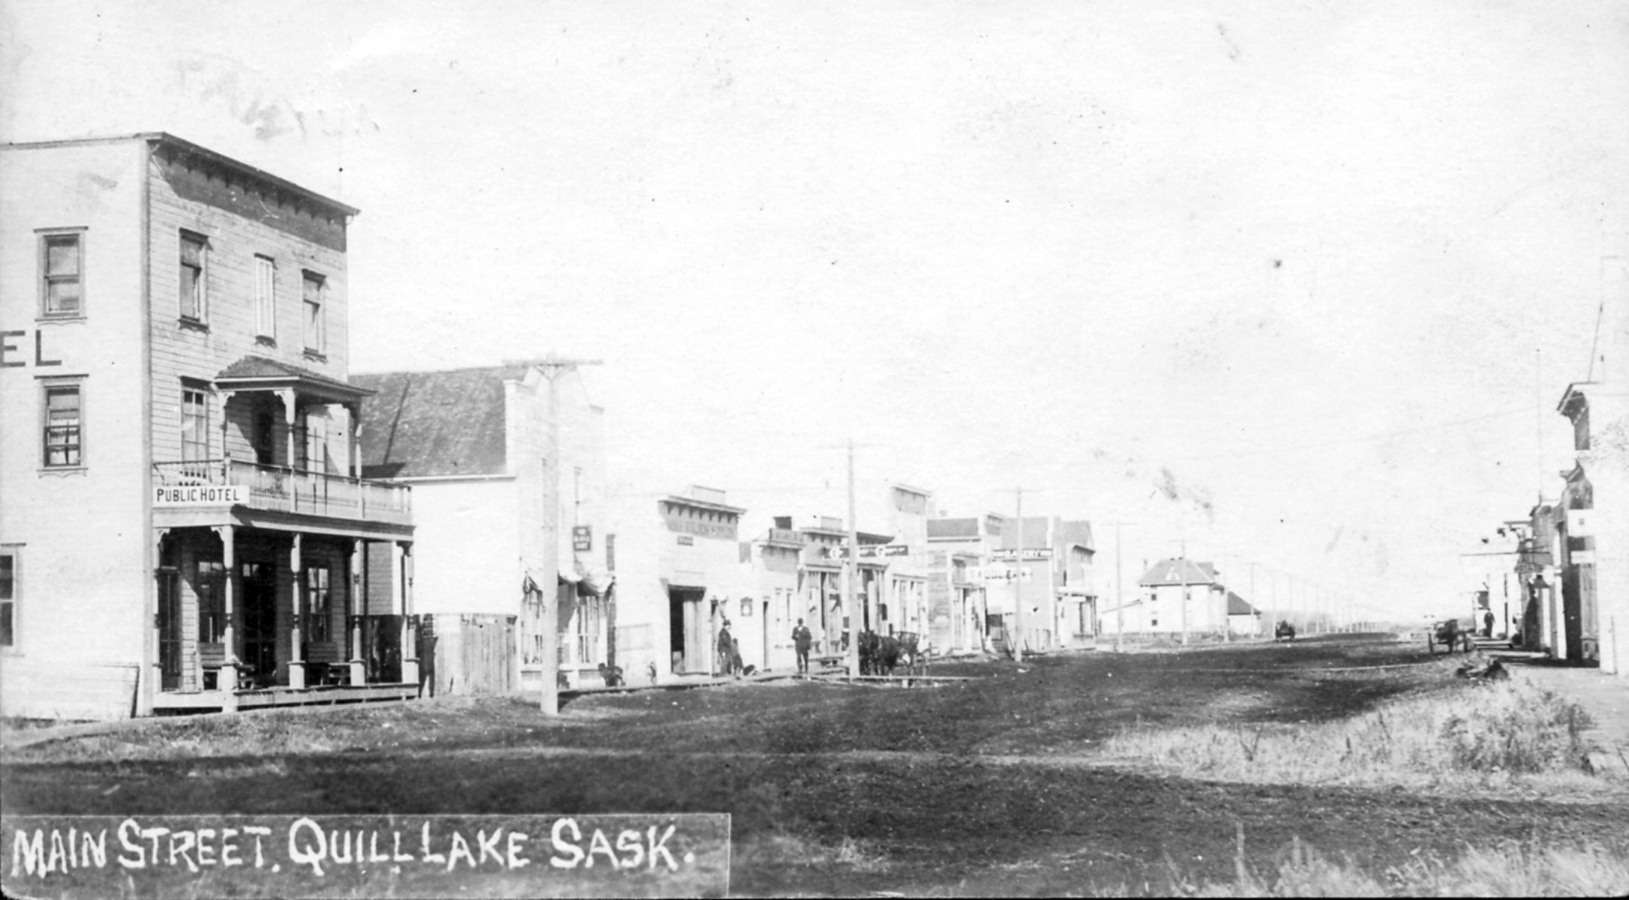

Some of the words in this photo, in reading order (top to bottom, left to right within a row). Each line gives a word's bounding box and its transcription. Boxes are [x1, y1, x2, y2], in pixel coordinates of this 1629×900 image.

[0, 330, 62, 367] EL
[156, 488, 197, 502] PUBLIC
[200, 488, 240, 501] HOTEL
